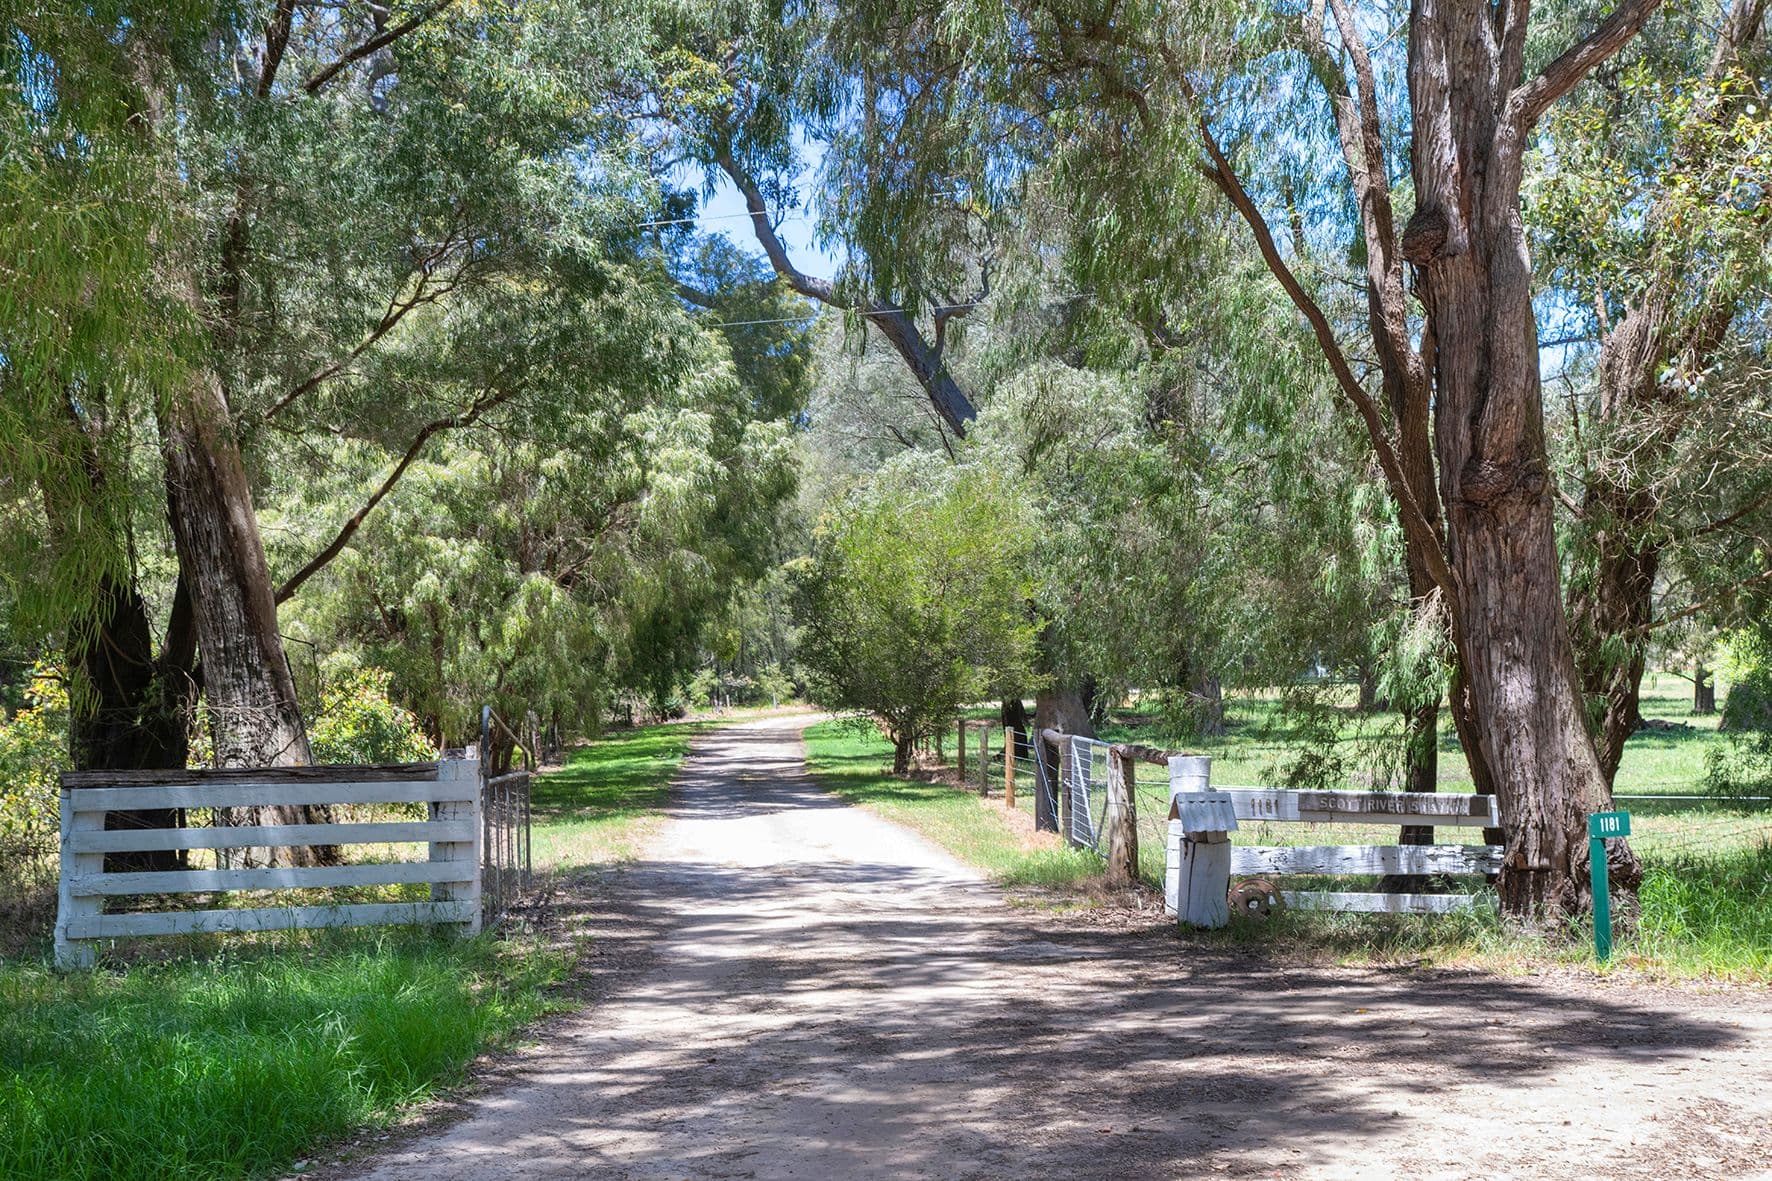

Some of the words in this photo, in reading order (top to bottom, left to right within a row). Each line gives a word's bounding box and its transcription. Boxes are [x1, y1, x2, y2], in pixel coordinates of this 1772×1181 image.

[1319, 797, 1361, 813] SCOTT
[1367, 799, 1405, 815] RIVER
[1600, 817, 1620, 833] 1181
